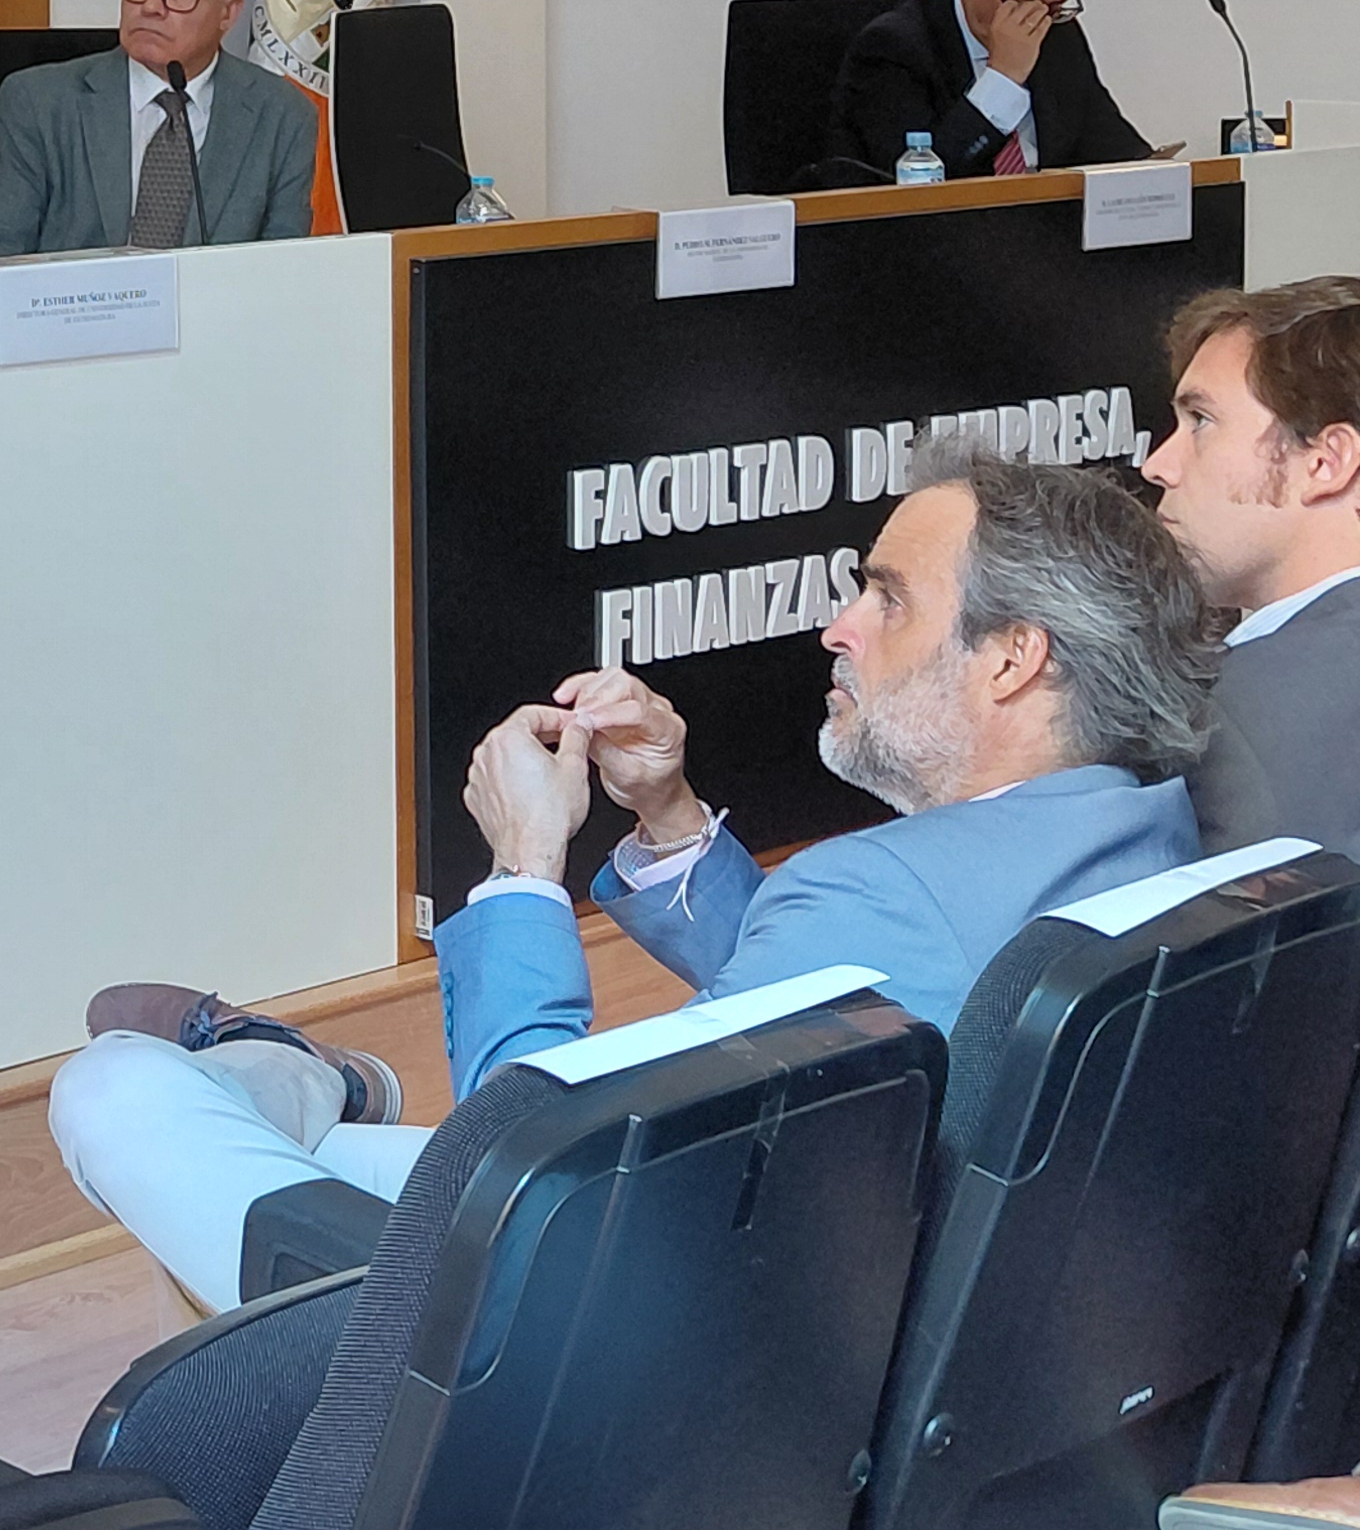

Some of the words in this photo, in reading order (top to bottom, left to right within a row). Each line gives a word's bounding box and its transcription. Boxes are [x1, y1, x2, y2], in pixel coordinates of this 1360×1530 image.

[43, 295, 75, 307] ESTHER
[567, 434, 834, 551] FACULTAD
[847, 420, 914, 503] DE
[594, 546, 861, 669] FINANZAS
